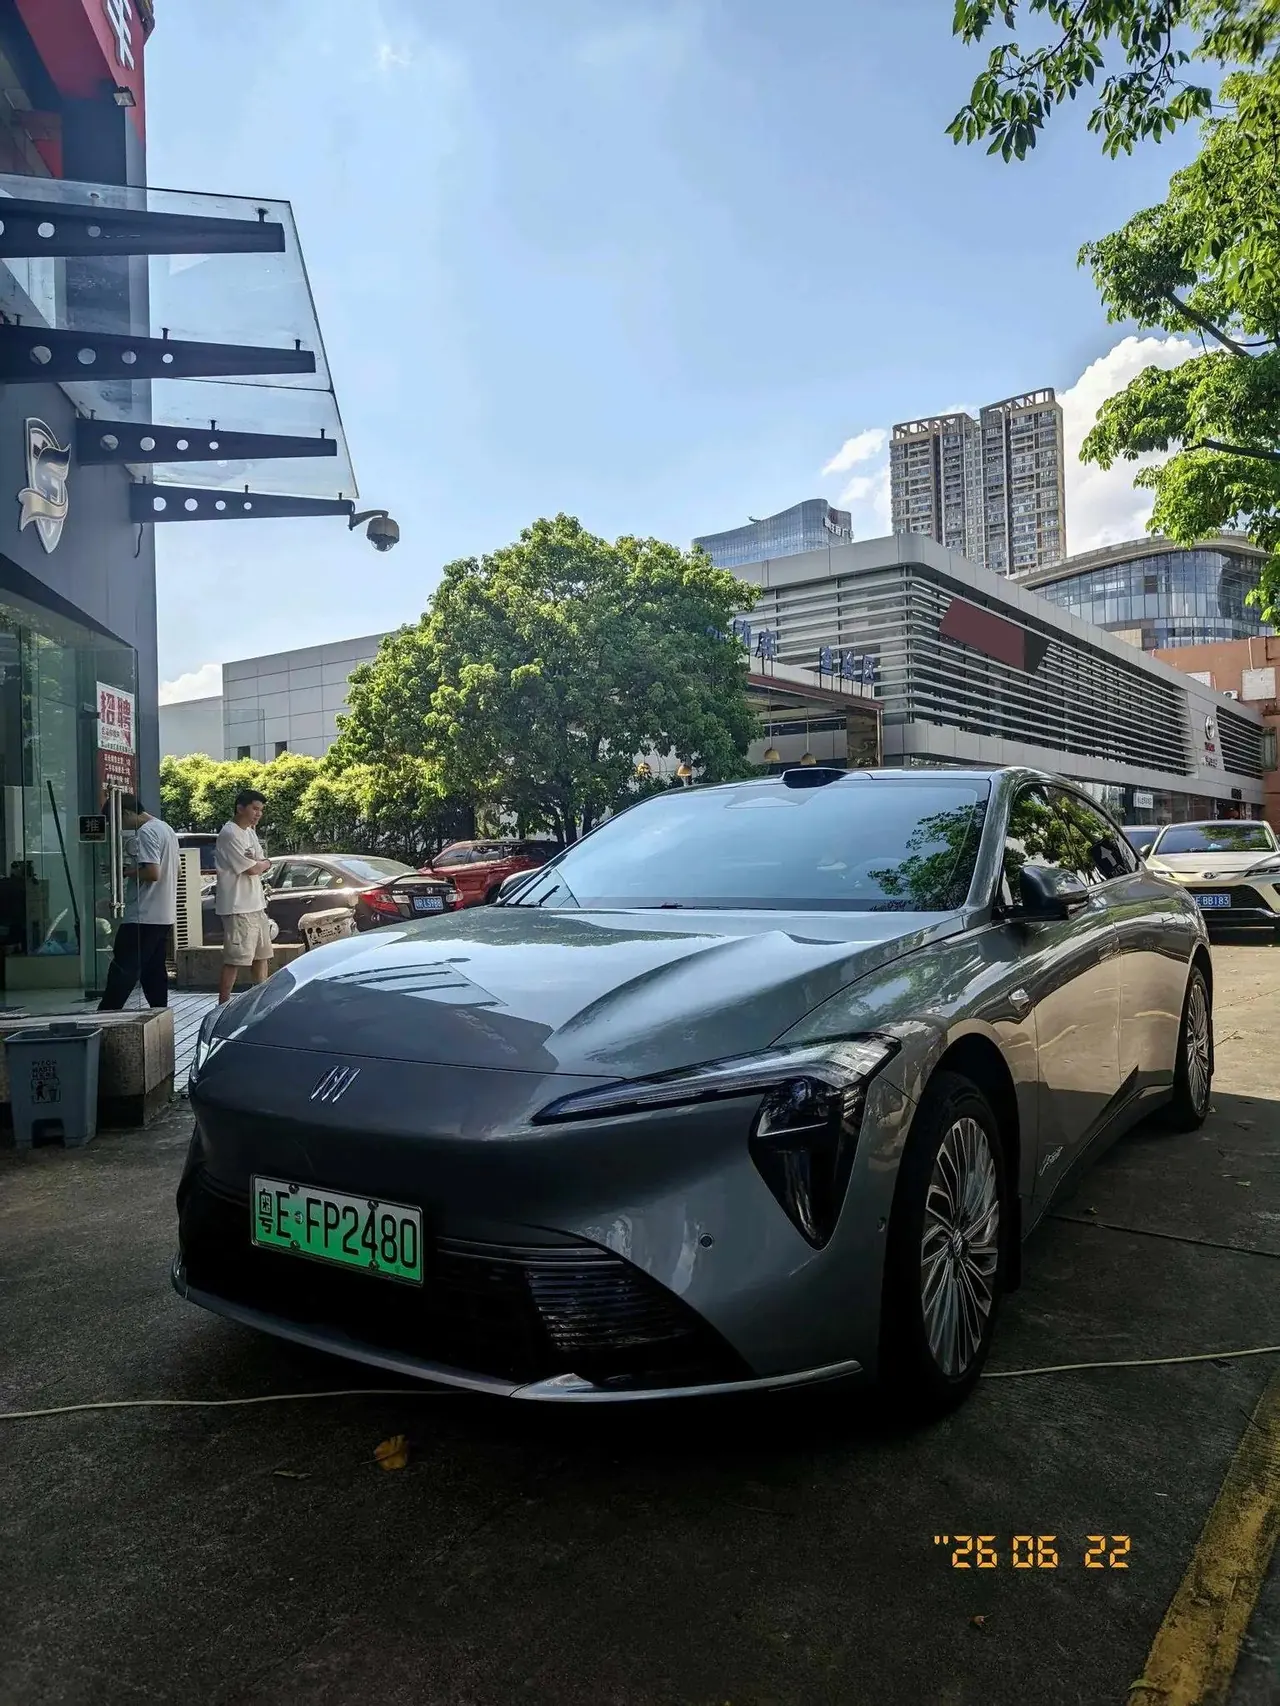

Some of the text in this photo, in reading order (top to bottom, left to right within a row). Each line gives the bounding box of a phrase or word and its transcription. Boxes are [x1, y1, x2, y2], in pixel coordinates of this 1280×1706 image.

[100, 691, 131, 740] 招聘
[84, 818, 100, 832] 推
[1195, 896, 1229, 905] EBB183
